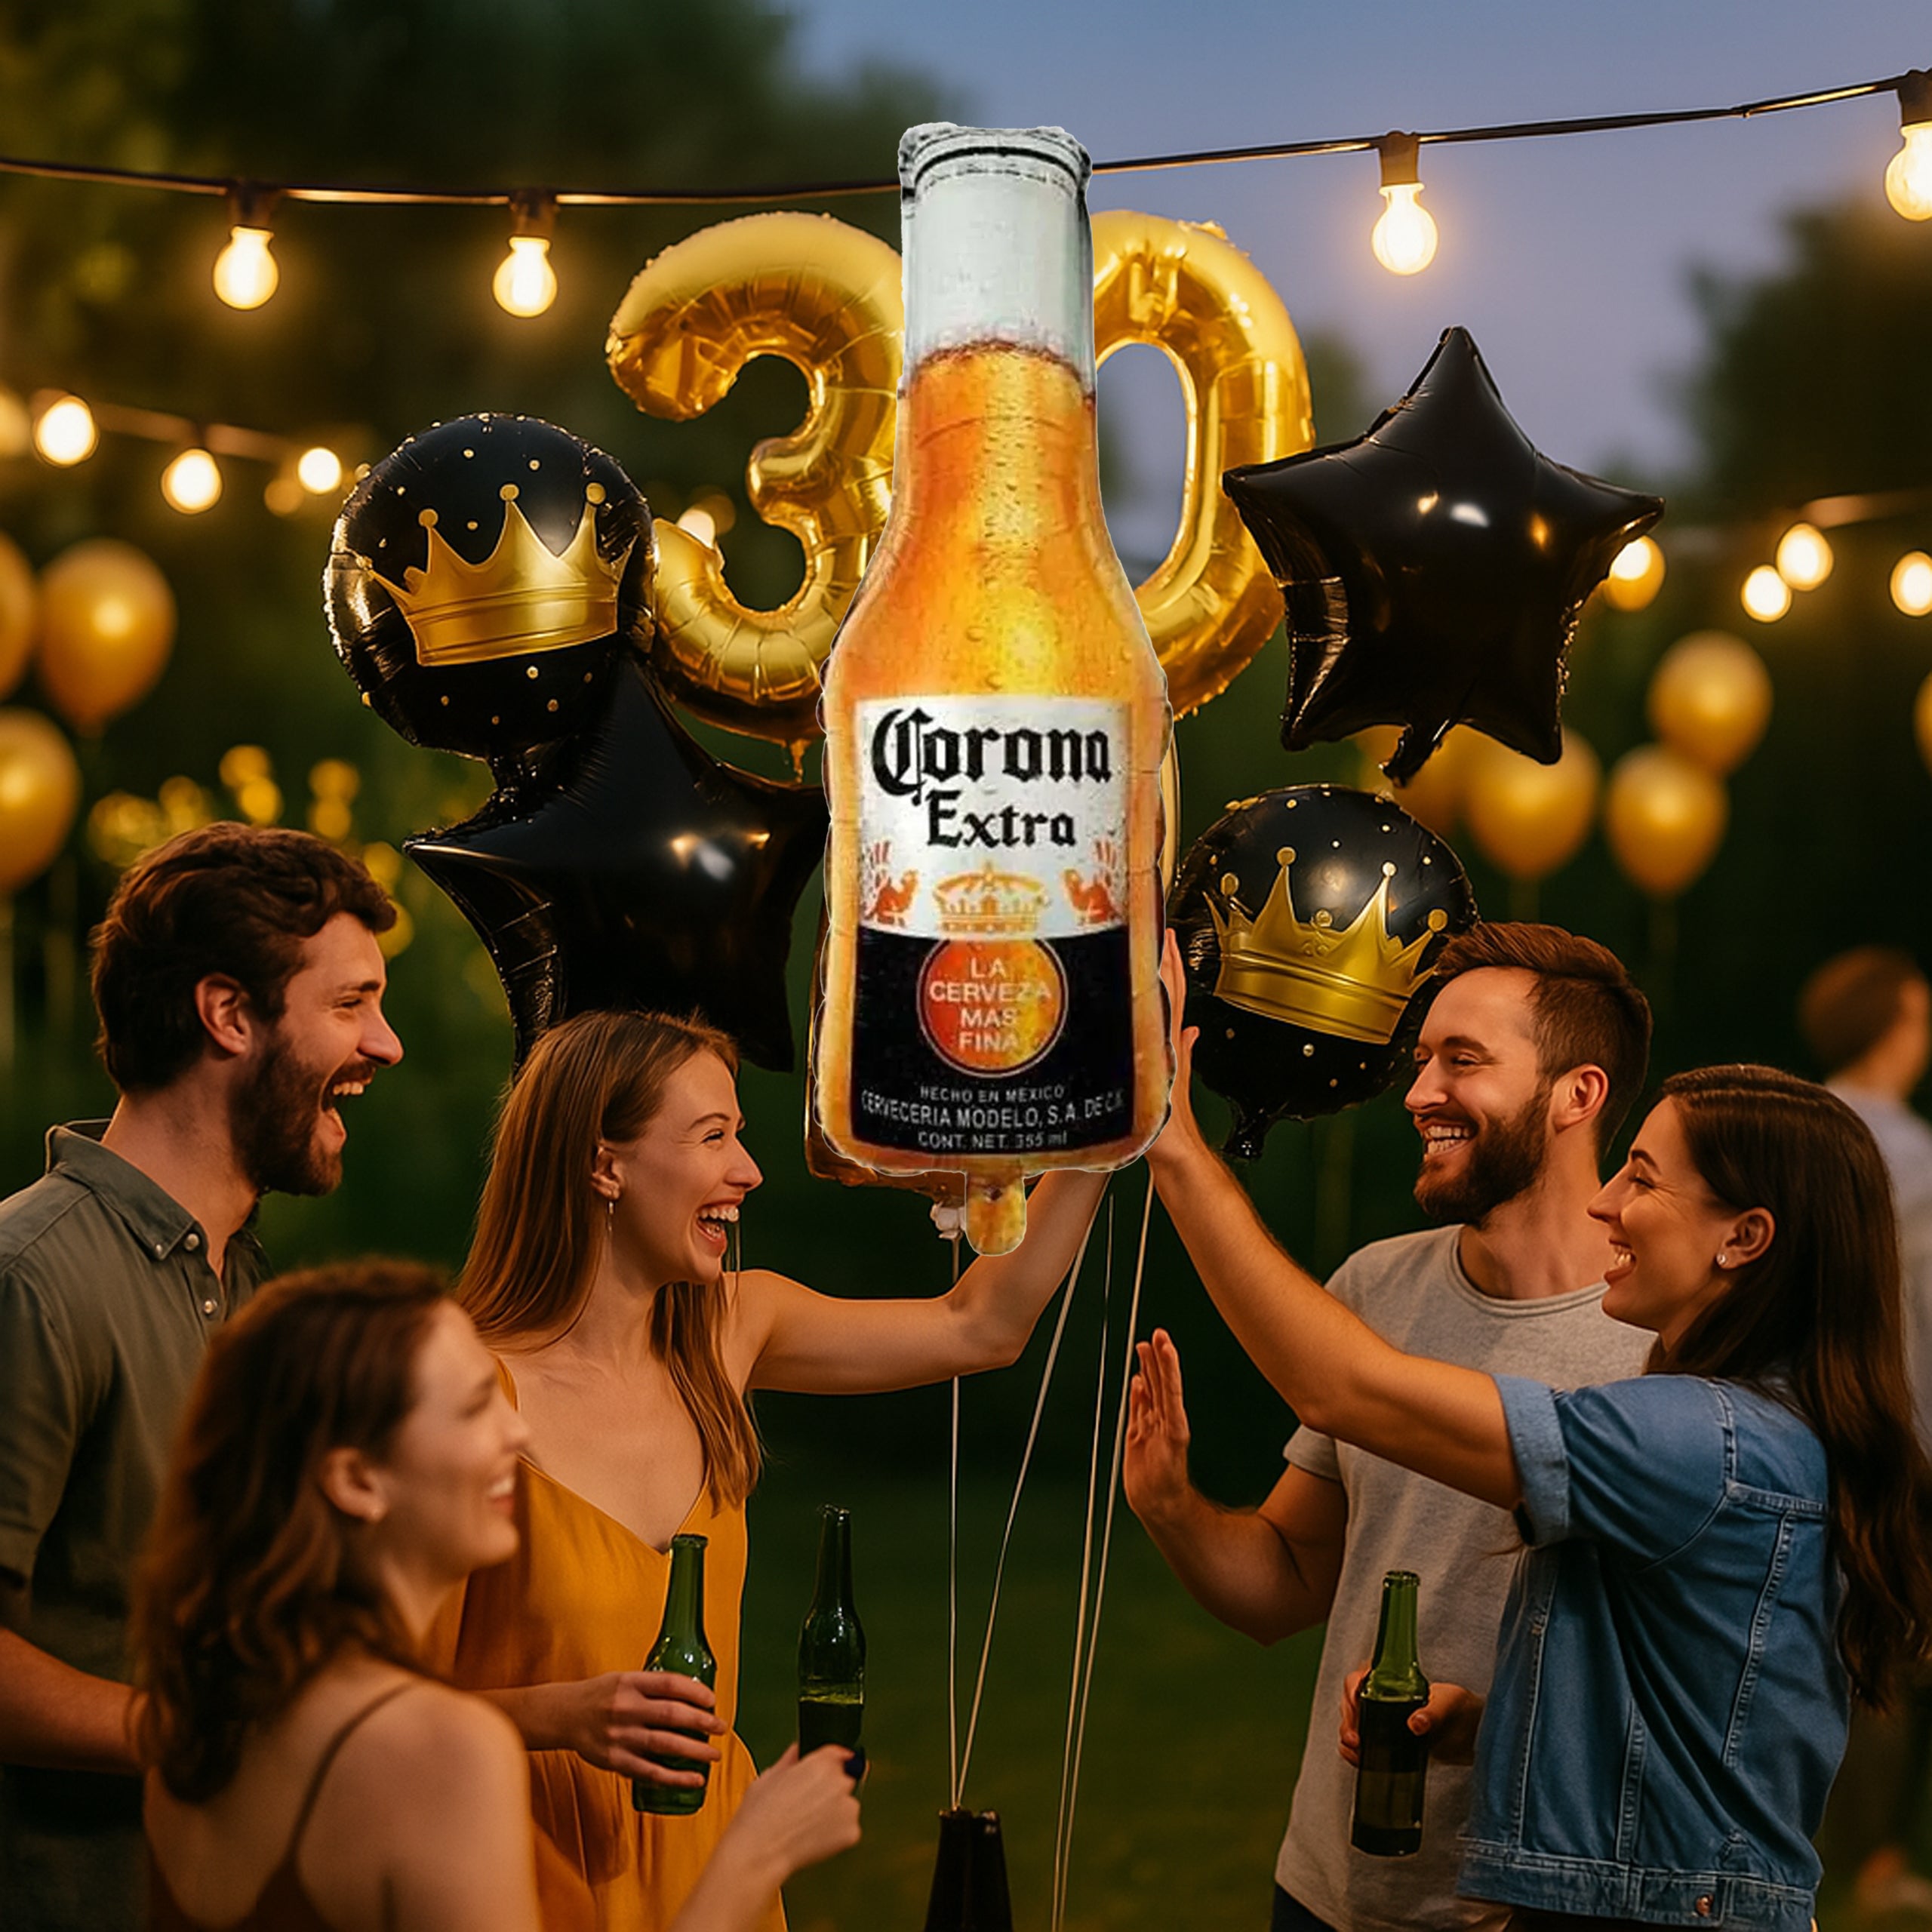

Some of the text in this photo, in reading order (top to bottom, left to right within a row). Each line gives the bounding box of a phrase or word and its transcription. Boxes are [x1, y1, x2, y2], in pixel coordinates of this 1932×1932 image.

[872, 707, 1112, 806] Corona
[927, 790, 1076, 848] Extra
[971, 957, 1007, 978] LA
[929, 980, 1051, 1003] CERVEZA
[961, 1007, 1017, 1028] MAS
[958, 1031, 1019, 1053] FINA
[920, 1085, 973, 1103] HECHO
[978, 1090, 999, 1103] EN
[861, 1089, 952, 1128] CERVECERIA
[1084, 1095, 1103, 1119] DE
[1014, 1132, 1044, 1149] 355
